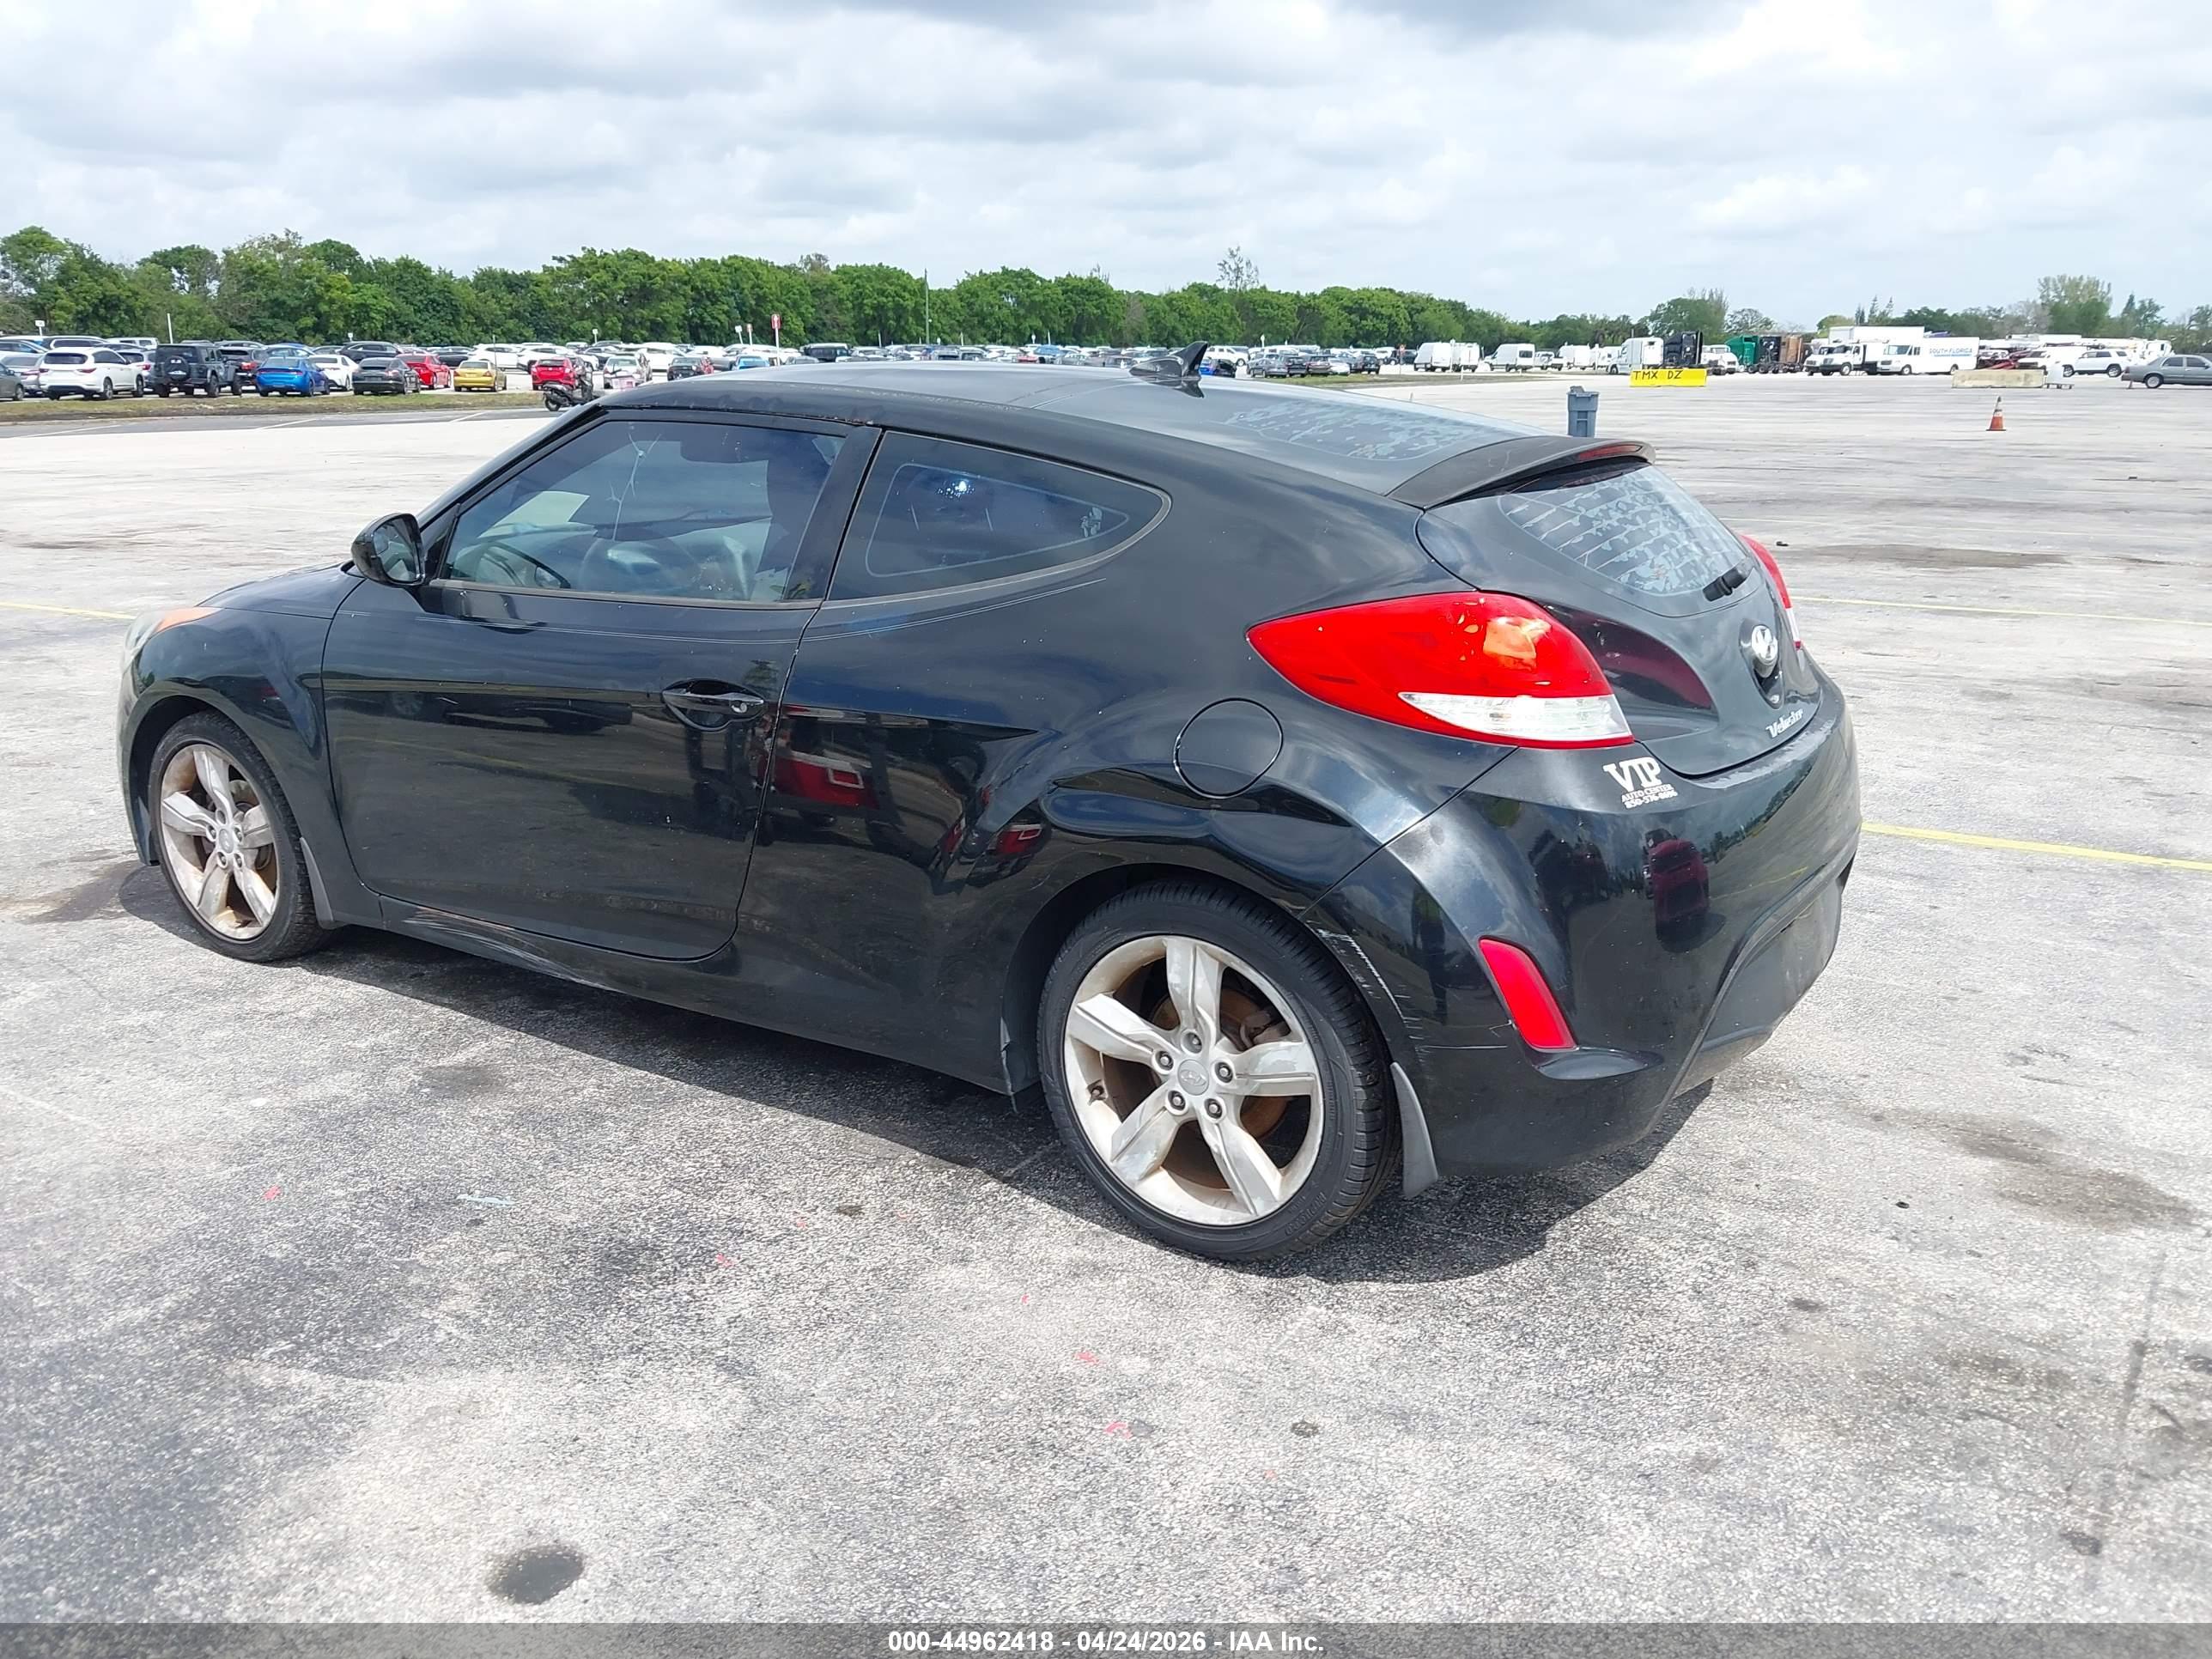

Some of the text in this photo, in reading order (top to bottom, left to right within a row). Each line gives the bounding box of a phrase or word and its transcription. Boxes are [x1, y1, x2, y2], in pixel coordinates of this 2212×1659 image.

[1633, 370, 1684, 380] TMX DZ
[1602, 757, 1662, 793] VIP
[1621, 789, 1645, 803] AUTO
